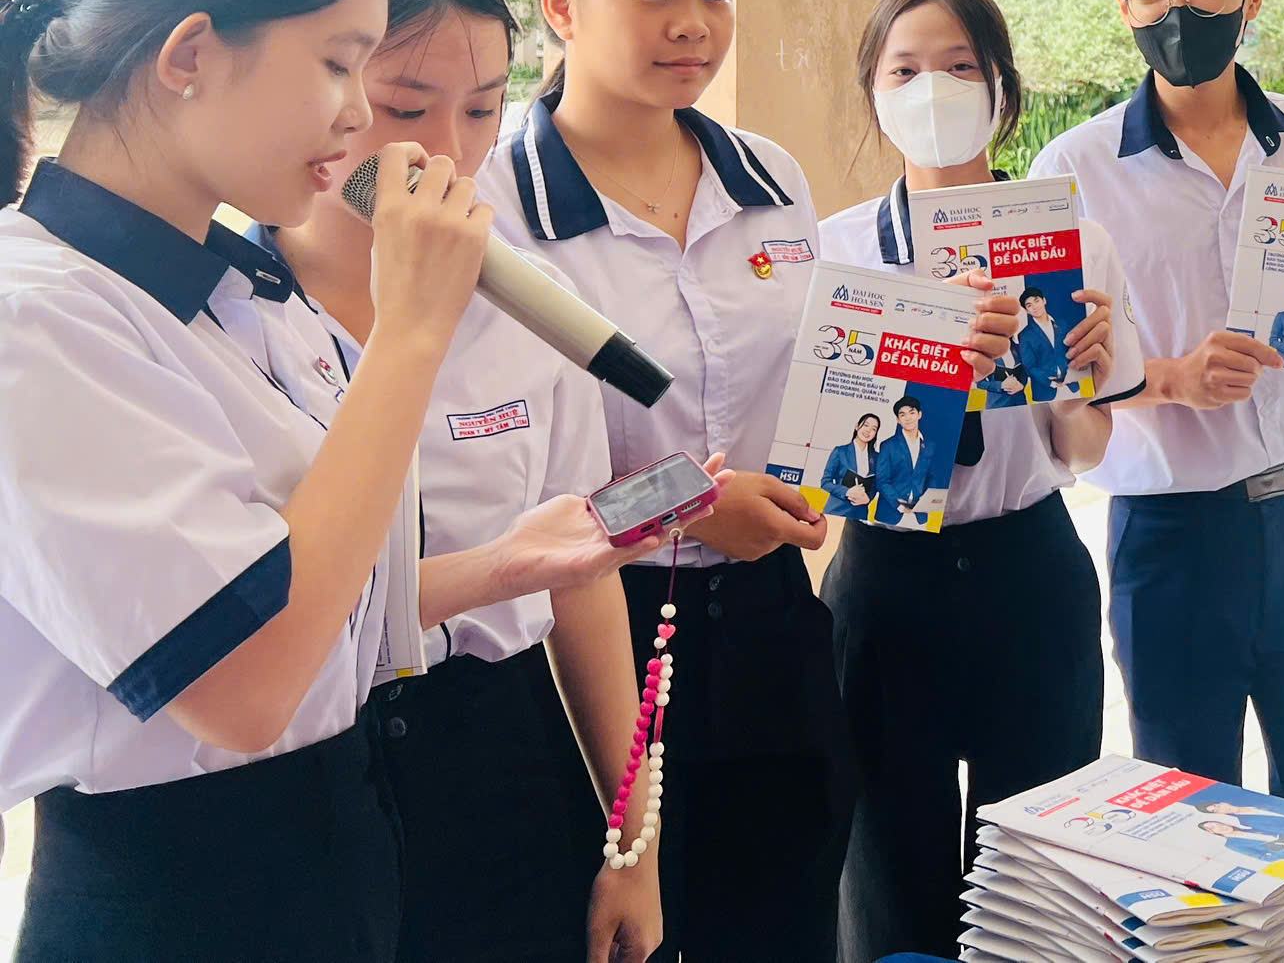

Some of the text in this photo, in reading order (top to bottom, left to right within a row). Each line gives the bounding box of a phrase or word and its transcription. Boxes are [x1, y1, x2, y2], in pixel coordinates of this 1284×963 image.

[993, 236, 1054, 252] KHÁC BIỆT
[884, 337, 950, 360] KHÁC BIỆT
[780, 472, 799, 482] HSU
